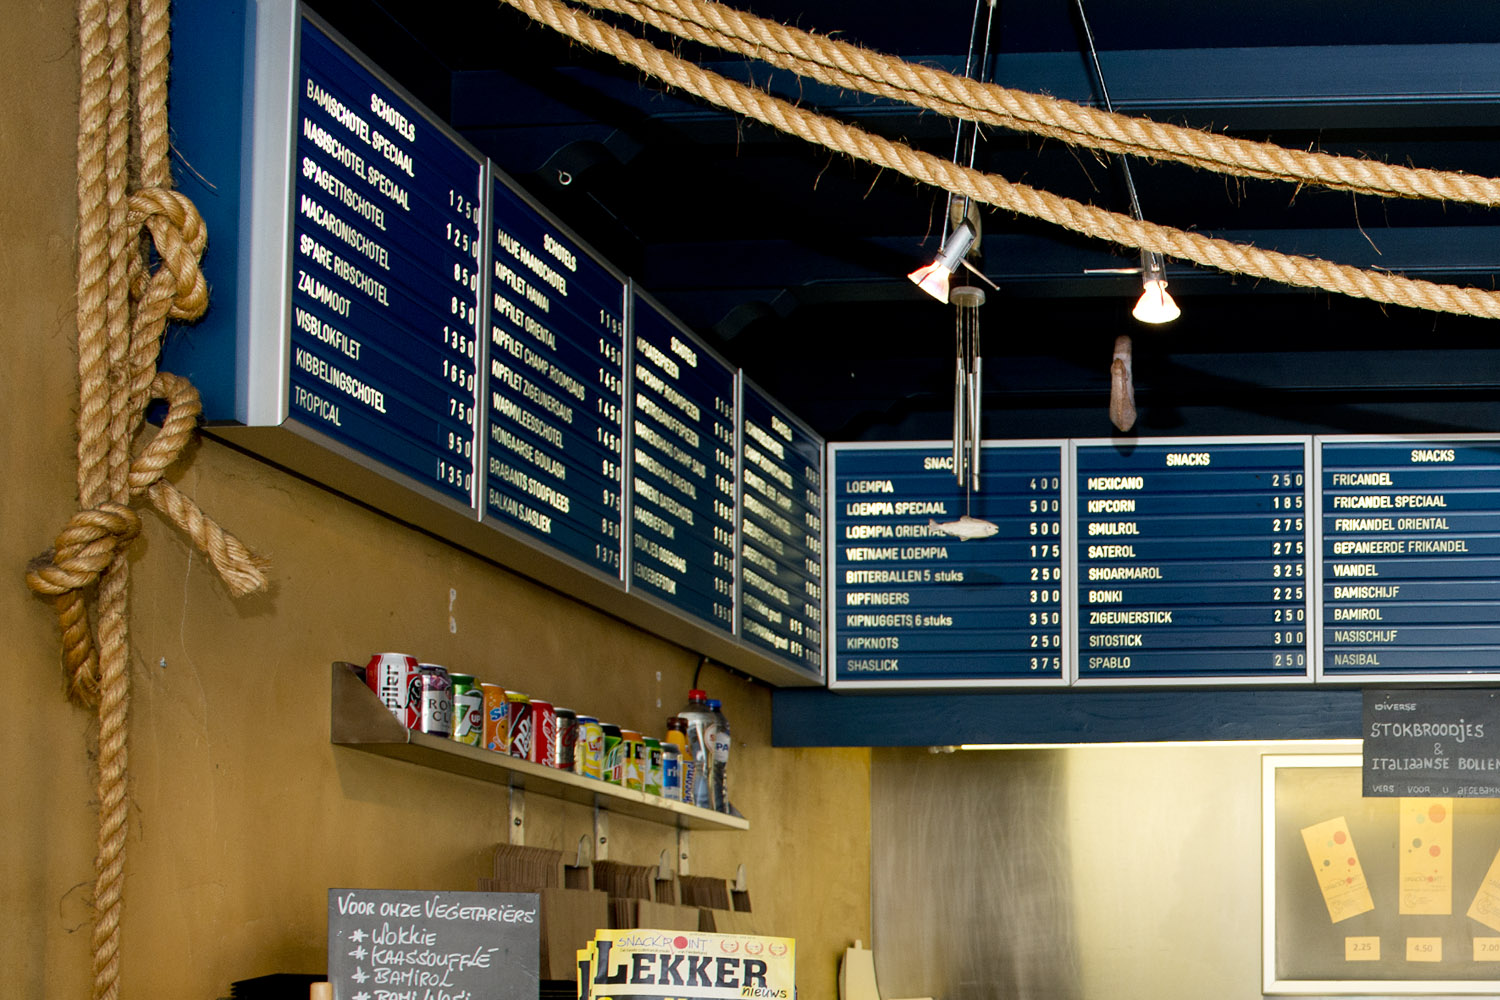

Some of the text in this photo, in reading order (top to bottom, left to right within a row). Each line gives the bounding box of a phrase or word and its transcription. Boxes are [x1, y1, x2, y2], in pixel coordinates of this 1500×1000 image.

[371, 94, 416, 142] SCHOTELS
[307, 79, 414, 178] BAMISCHOTEL SPECIAAL
[303, 157, 386, 231] SPAGETTISCHOTEL
[301, 194, 390, 270] MACARONISCHOTEL
[300, 234, 389, 307] SPARE RIBSCHOTEL
[298, 270, 351, 318] ZALMMOOT
[296, 307, 361, 361] VISBLOKFILET
[296, 348, 386, 413] KIBBELINGSCHOTEL
[295, 386, 341, 426] TROPICAL
[1167, 453, 1210, 466] SNACKS
[1411, 450, 1455, 462] SNACKS
[1088, 477, 1143, 490] MEXICANO
[1334, 473, 1393, 485] FRICANDEL
[847, 480, 894, 493] LOEMPIA
[1088, 500, 1135, 512] KIPCORN
[1334, 496, 1447, 508] FRICANDEL SPECIAAL
[847, 502, 946, 516] LOEMPIA SPECIAAL
[1089, 523, 1139, 535] SMULROL
[1336, 518, 1449, 531] FRIKANDEL ORIENTAL
[846, 547, 948, 561] VIETNAME LOEMPIA
[1088, 545, 1136, 558] SATEROL
[1334, 541, 1468, 554] GEPANEERDE FRIKANDEL
[846, 570, 963, 583] BITTERBALLEN 5 stuks
[1089, 567, 1162, 580] SHOARMAROL
[1334, 564, 1378, 576] VIANDEL
[1089, 591, 1122, 603] BONKI
[1334, 586, 1399, 598] BAMISCHIJF
[847, 593, 909, 605] KIPFINGERS
[847, 614, 952, 626] KIPNUGGETS 6 stuks
[1090, 612, 1172, 624] ZIGEUNERSTICK
[1335, 609, 1382, 620] BAMIROL
[1090, 634, 1142, 647] SITOSTICK
[1335, 630, 1397, 642] NASISCHIJF
[847, 637, 898, 649] KIPKNOTS
[848, 659, 898, 671] SHASLICK
[1090, 657, 1130, 668] SPABLO
[1335, 654, 1380, 665] NASIBAL
[1434, 743, 1443, 755] &
[683, 760, 695, 803] hocomel
[1373, 785, 1394, 793] VERS
[1408, 785, 1430, 793] VOOR
[594, 941, 767, 989] LEKKER
[741, 983, 788, 999] nieuws
